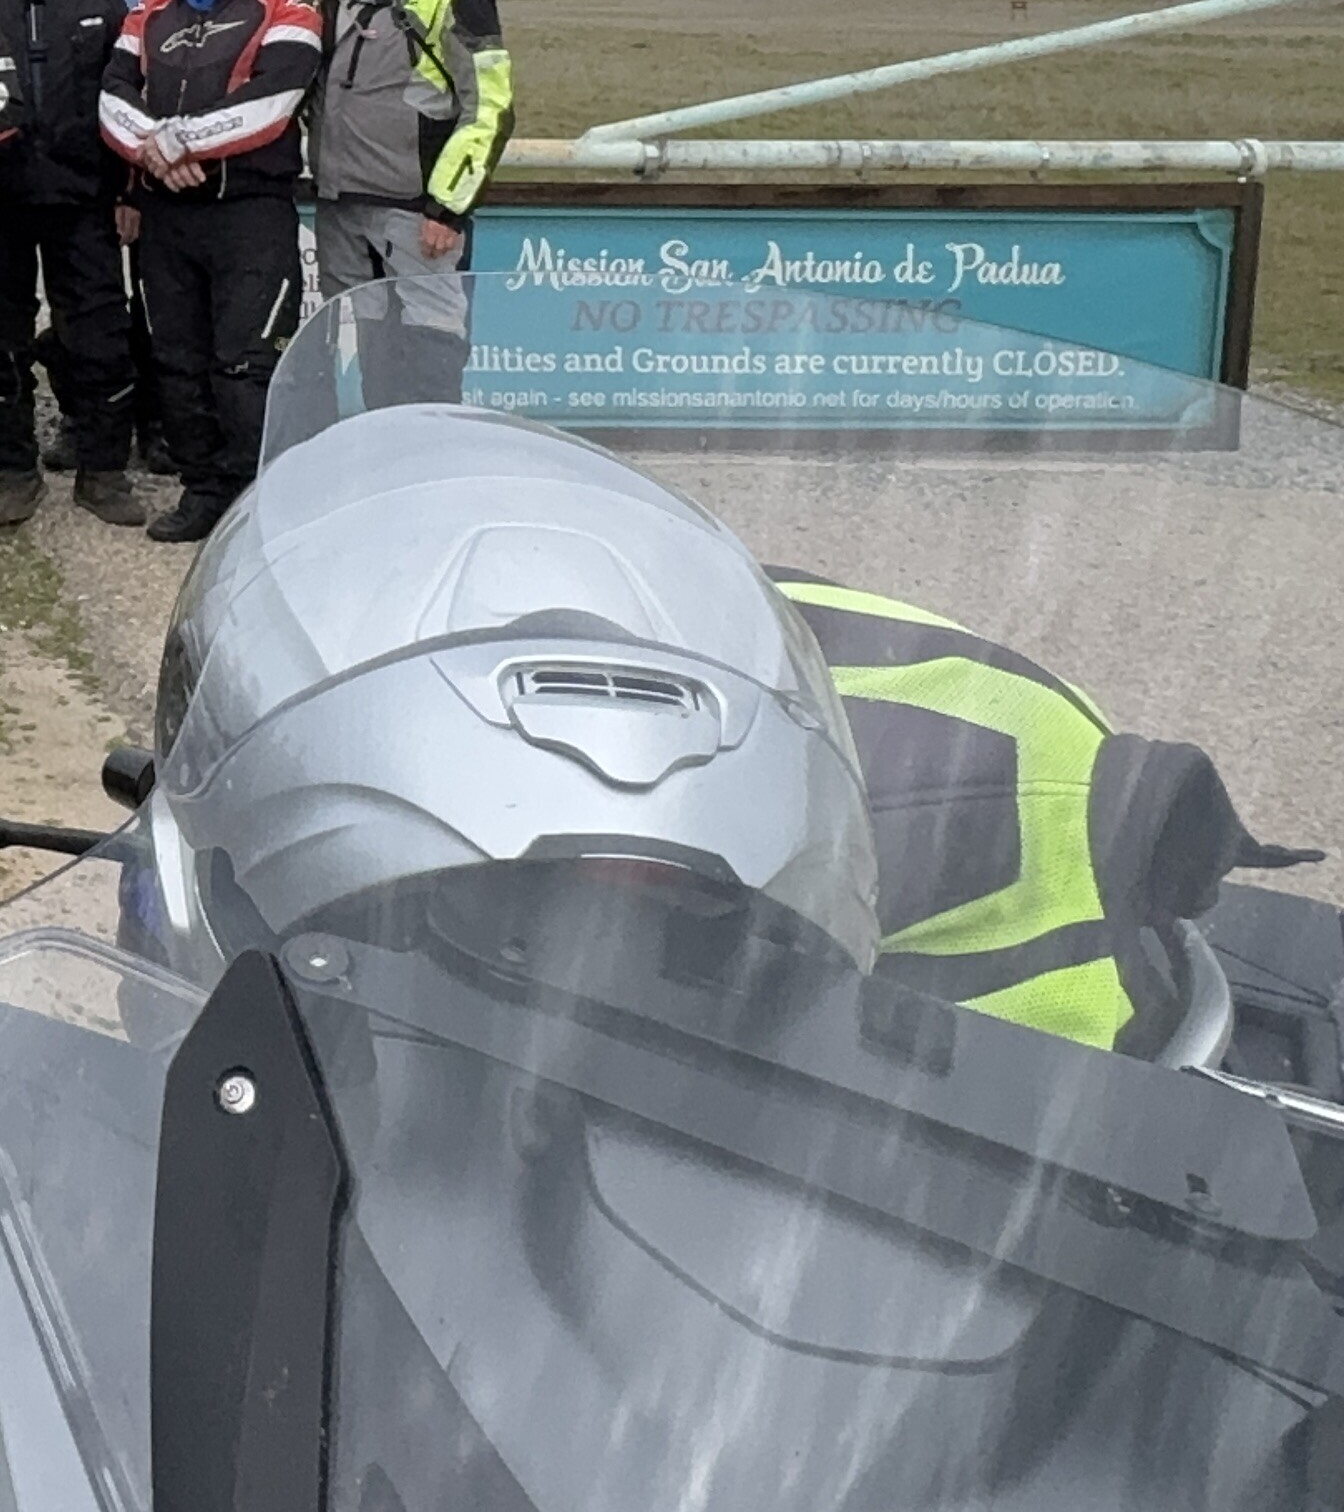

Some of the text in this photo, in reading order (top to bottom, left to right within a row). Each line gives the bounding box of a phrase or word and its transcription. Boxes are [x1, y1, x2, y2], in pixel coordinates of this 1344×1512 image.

[506, 237, 1067, 294] Mission San Antonio de Padua
[570, 298, 962, 334] NO TRESPASSING
[464, 345, 1126, 382] ilities and Grounds are currently CLOSED.
[490, 388, 548, 410] again
[568, 391, 606, 407] see
[853, 389, 881, 408] for
[886, 389, 1004, 412] days/hours
[1008, 389, 1030, 409] of
